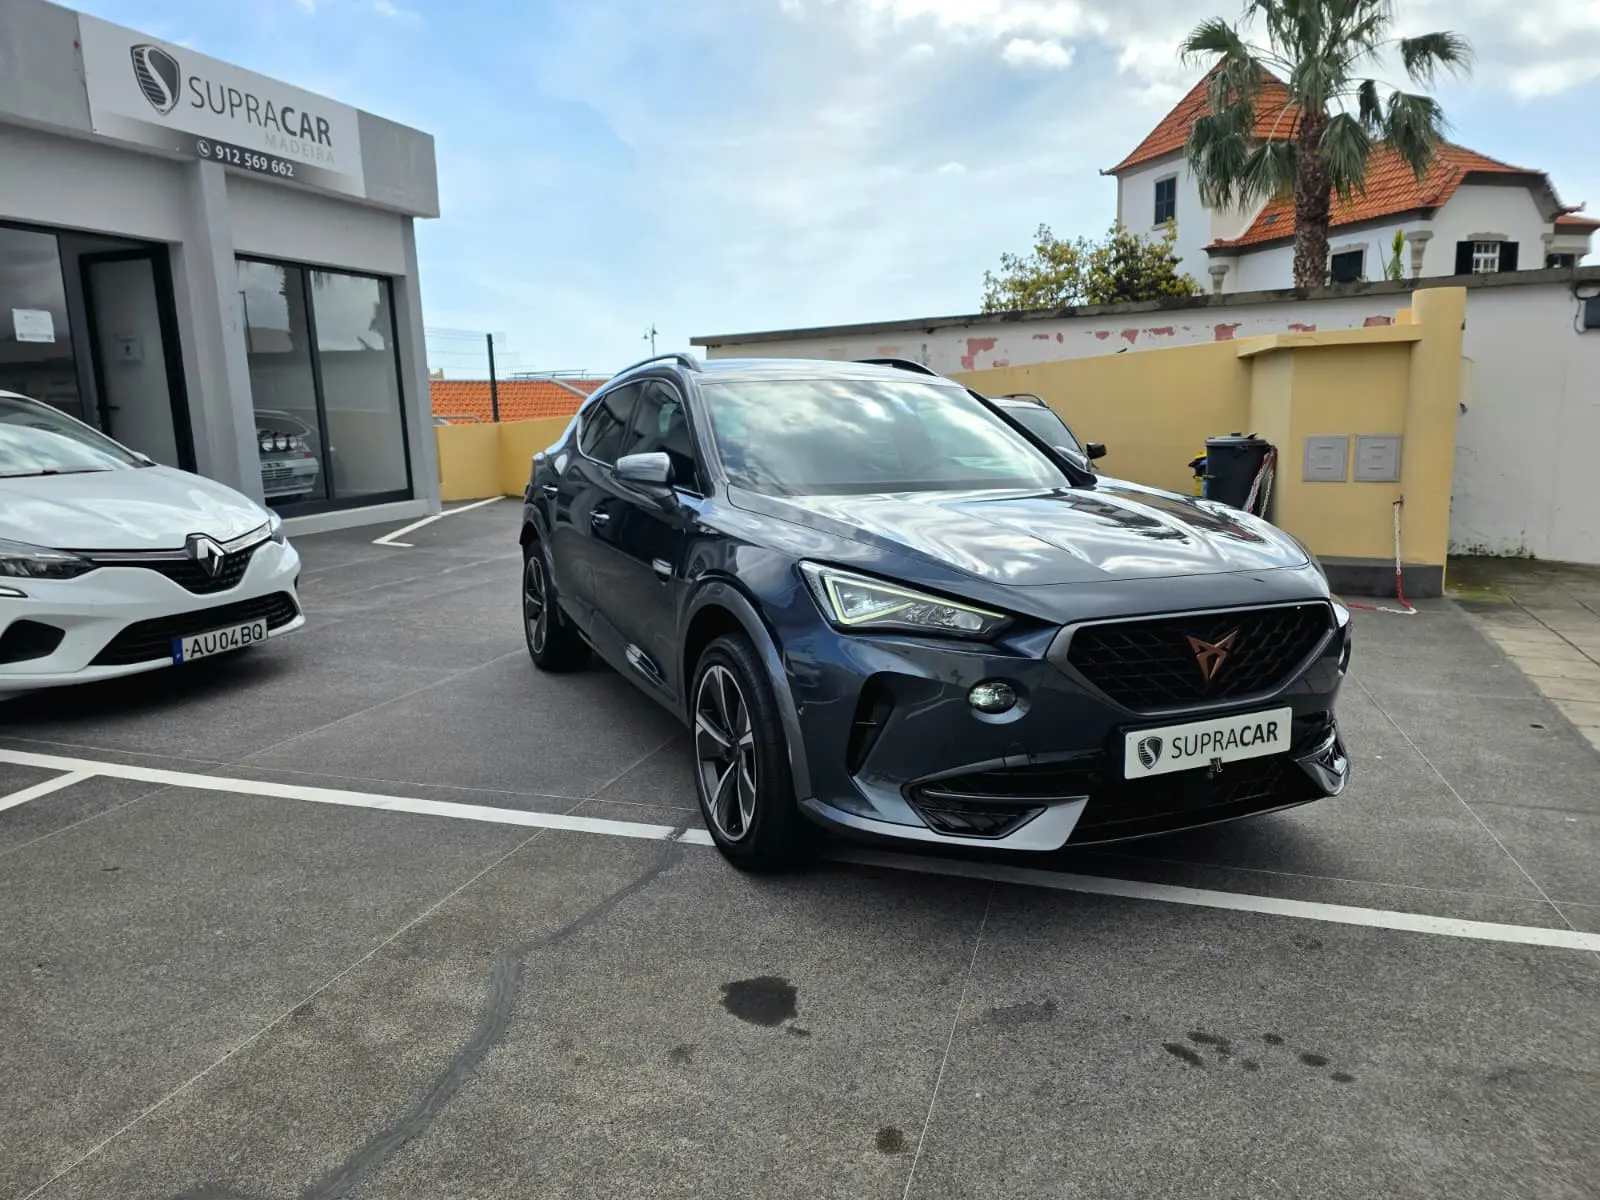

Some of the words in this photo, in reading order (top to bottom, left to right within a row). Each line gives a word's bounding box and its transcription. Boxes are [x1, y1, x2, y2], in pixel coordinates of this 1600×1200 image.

[189, 76, 332, 146] SUPRACAR
[215, 145, 241, 164] 912
[244, 153, 268, 170] 569
[271, 160, 295, 177] 662
[265, 133, 334, 163] MADEIRA
[1171, 721, 1278, 759] SUPRACAR
